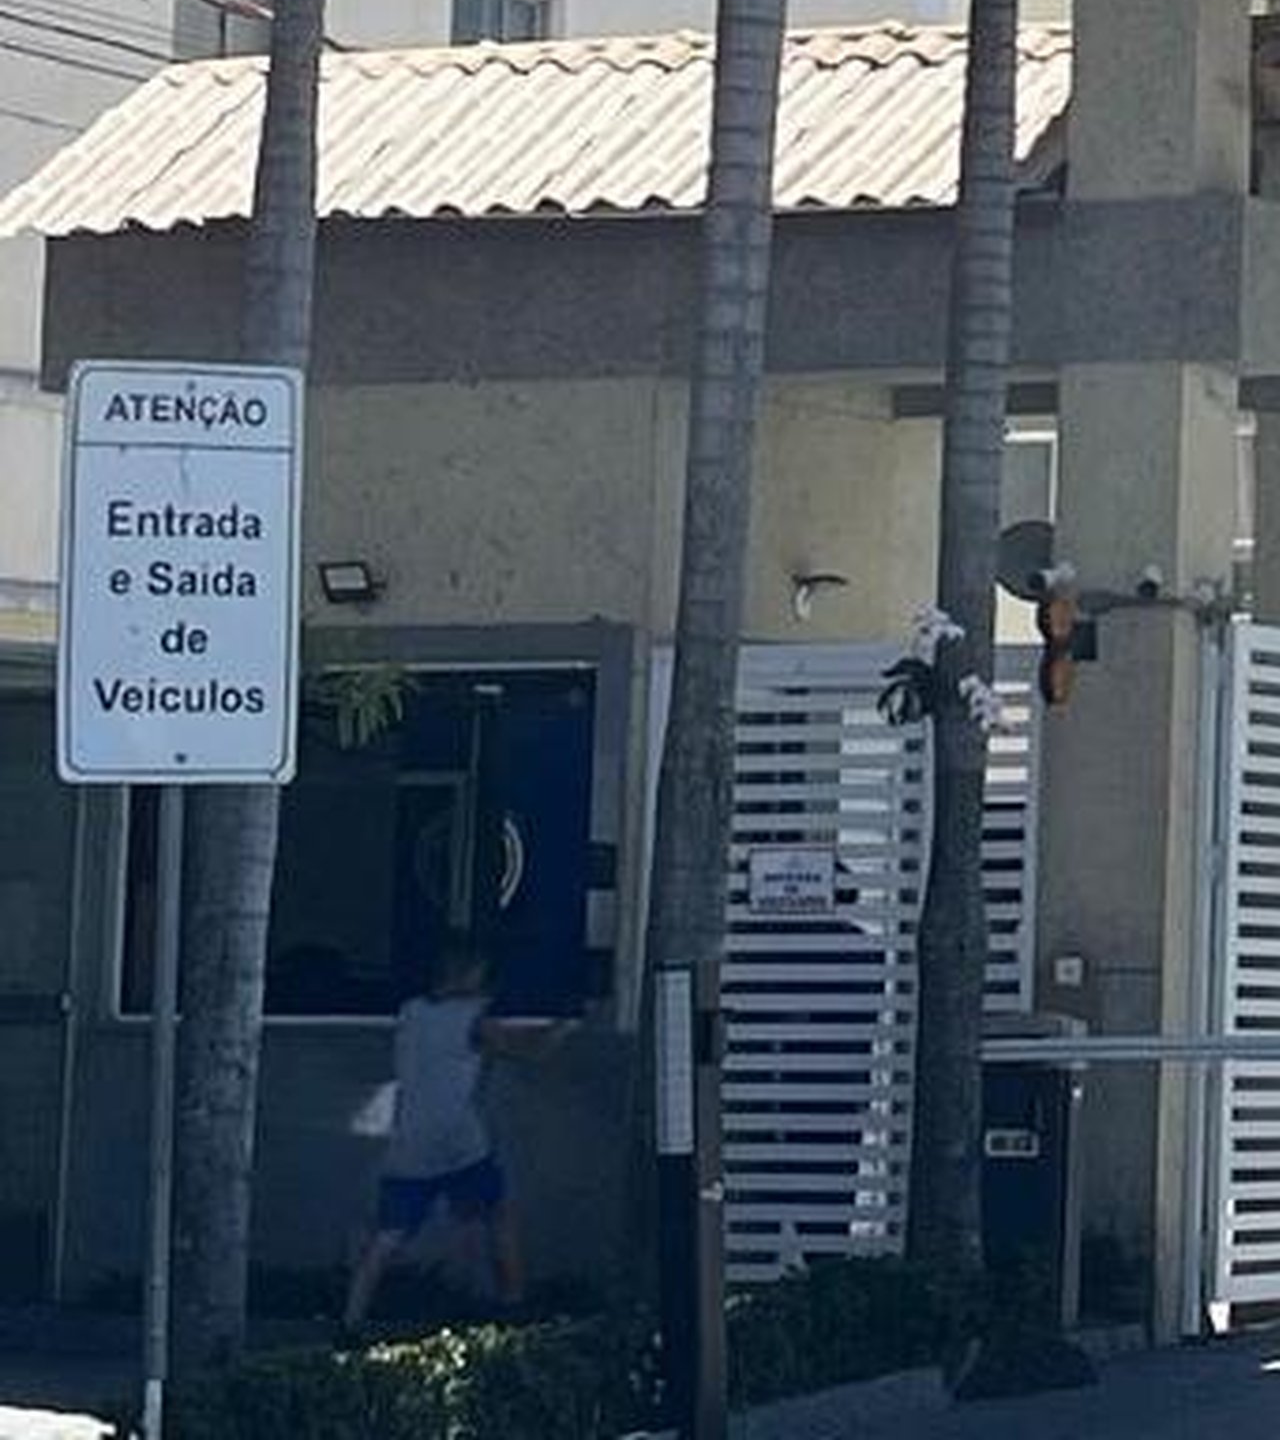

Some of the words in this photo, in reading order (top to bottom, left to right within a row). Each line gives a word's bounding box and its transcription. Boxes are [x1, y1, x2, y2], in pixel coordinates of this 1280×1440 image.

[107, 501, 261, 539] Entrada
[109, 568, 132, 595] e
[160, 622, 209, 655] de
